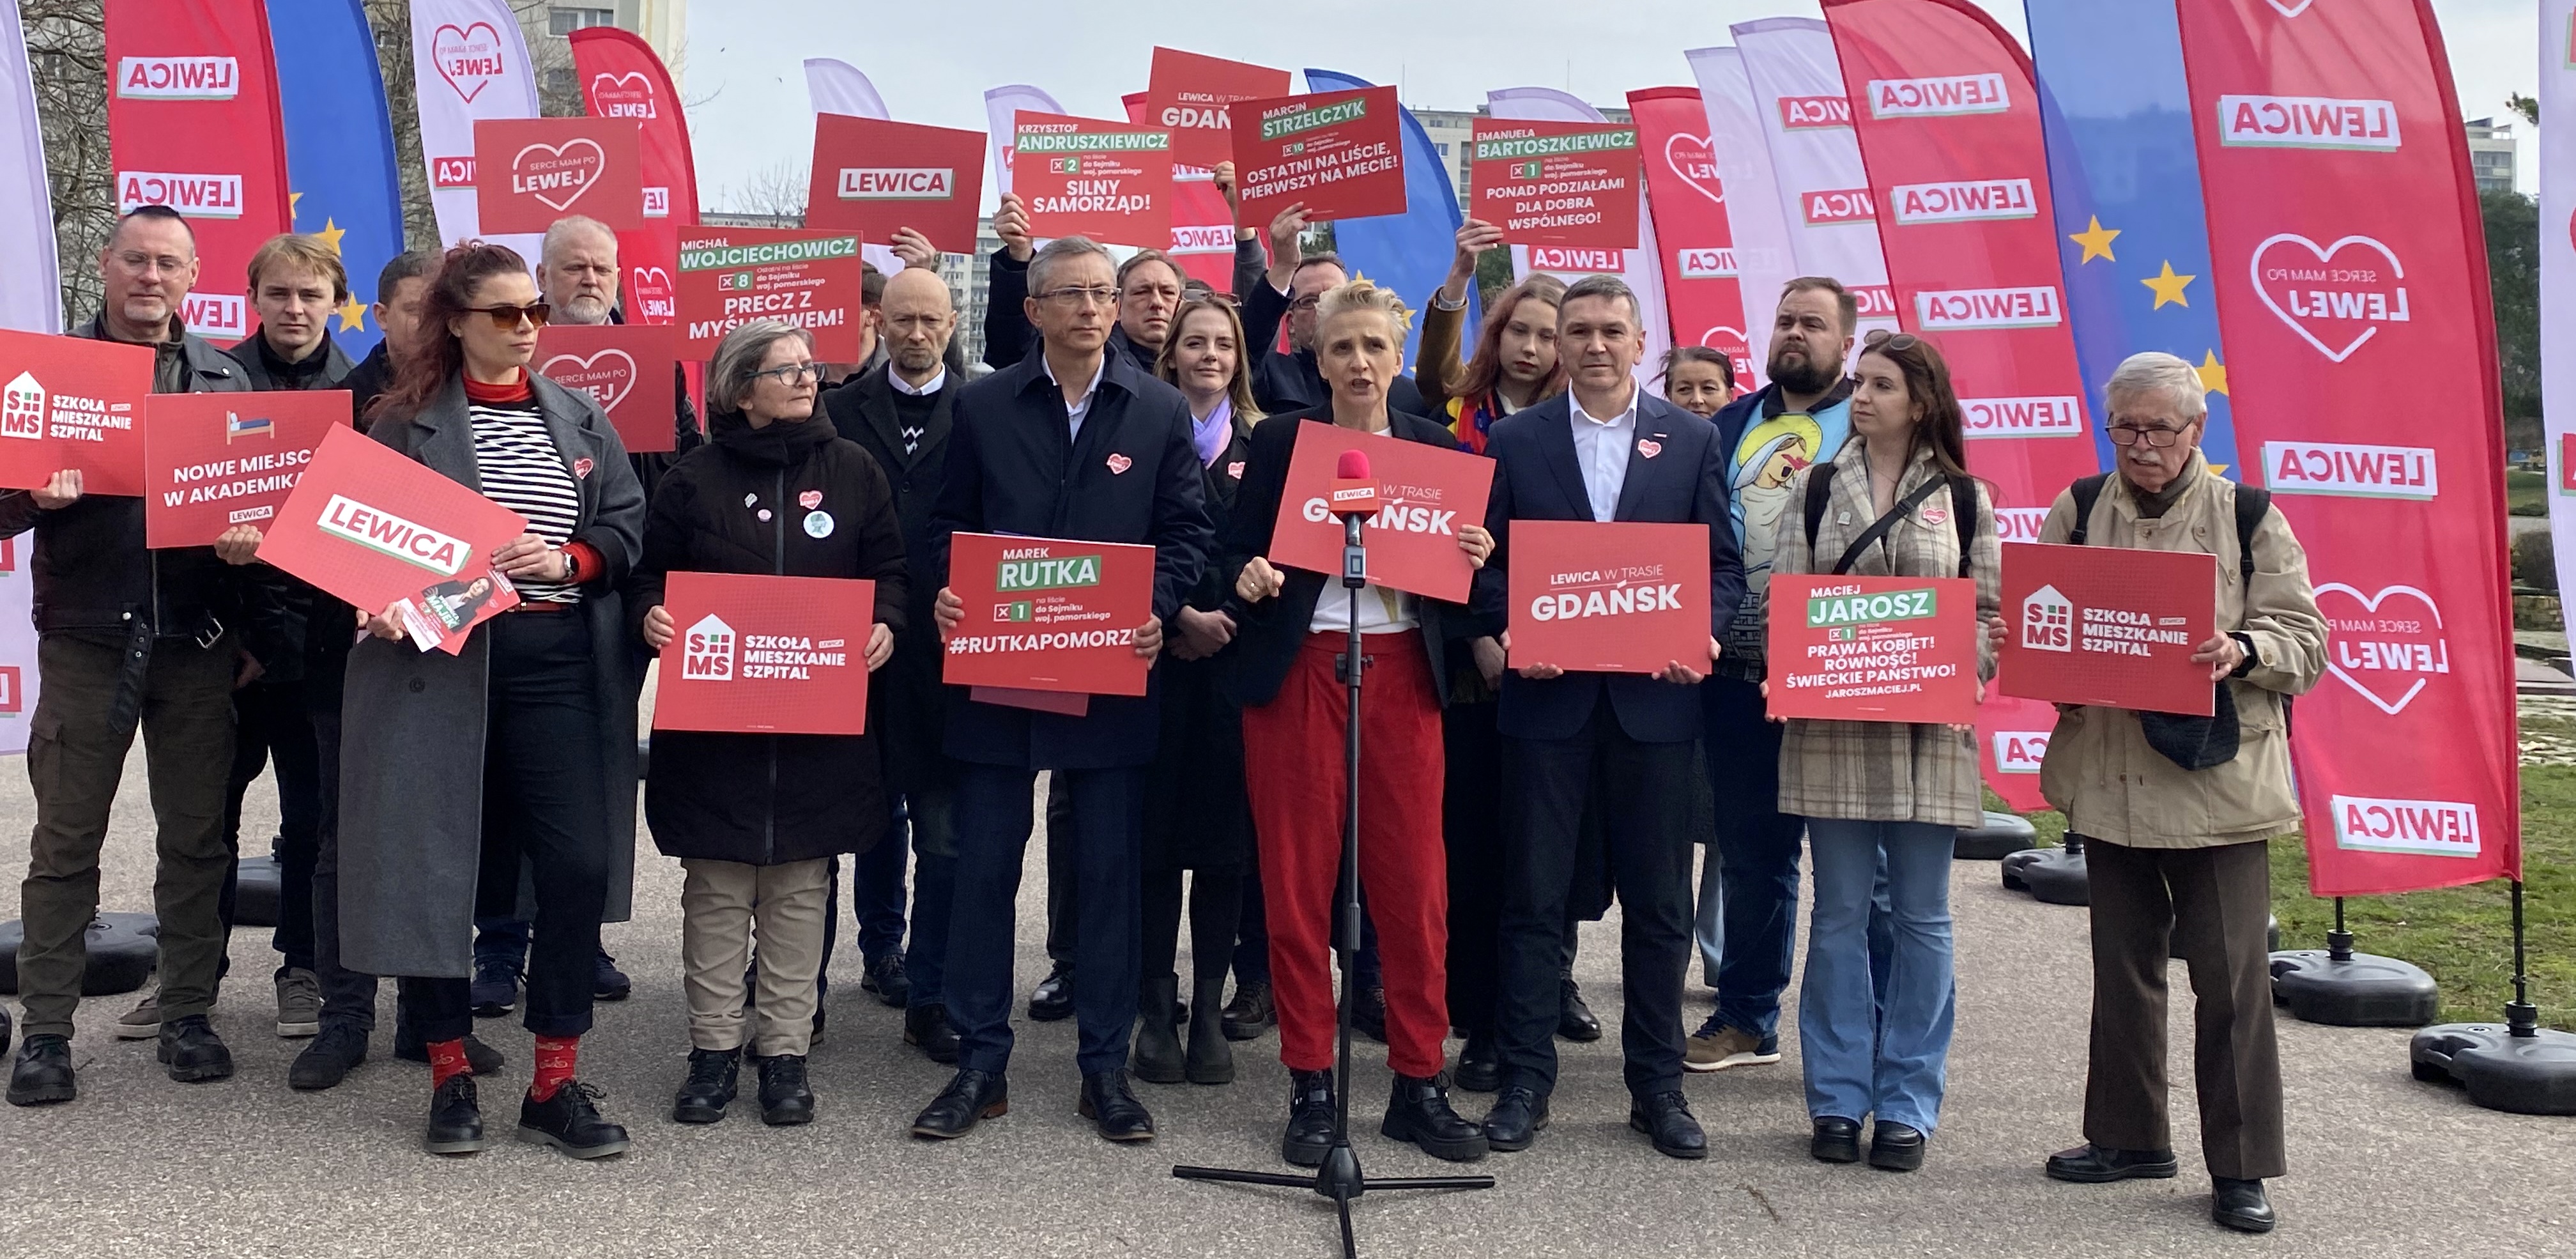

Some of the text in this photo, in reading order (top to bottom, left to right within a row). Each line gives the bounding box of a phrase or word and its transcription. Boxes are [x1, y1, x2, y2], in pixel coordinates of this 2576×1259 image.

[1178, 92, 1213, 102] LEWICA
[1216, 95, 1225, 103] W
[1162, 105, 1231, 130] GDAŃ
[1262, 102, 1307, 120] MARCIN
[1263, 100, 1365, 137] STRZELCZYK
[1018, 124, 1078, 134] KRZYSZTOF
[1476, 128, 1535, 141] EMANUELA
[1018, 134, 1168, 150] ANDRUSZKIEWICZ
[1293, 143, 1303, 153] 10
[1478, 132, 1634, 158] BARTOSZKIEWICZ
[530, 156, 596, 171] SERCE MAM PO
[1068, 160, 1077, 171] 2
[1247, 158, 1312, 183] OSTATNI
[1316, 153, 1338, 169] NA
[1341, 142, 1391, 164] LIŚCIE,
[1530, 164, 1535, 176] 1
[512, 169, 585, 194] LEWEJ
[846, 173, 945, 192] LEWICA
[1242, 155, 1398, 201] PIERWSZY NA MECIE!
[1066, 180, 1121, 196] SILNY
[1487, 178, 1625, 199] PONAD PODZIAŁAMI
[1033, 194, 1151, 215] SAMORZĄD!
[1516, 197, 1595, 213] DLA DOBRA
[1508, 211, 1602, 230] WSPÓLNEGO!
[680, 238, 855, 268] WOJCIECHOWICZ
[681, 237, 729, 251] MICHAŁ
[739, 274, 748, 287] 8
[769, 272, 800, 281] Sejmiku
[774, 278, 825, 290] pomorskiego
[724, 291, 811, 314] PRECZ Z
[555, 369, 627, 384] SERCE MAM PO
[52, 395, 105, 413] SZKOŁA
[51, 410, 132, 430] MIESZKANIE
[50, 424, 104, 442] SZPITAL
[174, 449, 311, 483] NOWE MIEJSC
[164, 472, 304, 507] W AKADEMIK
[1336, 489, 1373, 500] LEWICA
[1383, 484, 1443, 500] W TRASIE
[232, 507, 271, 521] LEWICA
[1303, 497, 1457, 536] GŃSK
[328, 502, 454, 568] LEWICA
[1003, 548, 1049, 560] MAREK
[1001, 559, 1097, 588] RUTKA
[1550, 564, 1664, 585] LEWICA W TRASIE
[1531, 580, 1682, 622] GDAŃSK
[1811, 585, 1861, 599] MACIEJ
[427, 595, 460, 629] MAJEK
[1017, 605, 1023, 619] 1
[1048, 603, 1083, 614] Sejmiku
[1811, 592, 1929, 624] JAROSZ
[2083, 608, 2151, 626] SZKOŁA
[1035, 611, 1111, 624] woj. pomorskiego
[949, 628, 1138, 654] #RUTKAPOMORZ
[1846, 629, 1851, 639] 1
[2082, 622, 2189, 645] MIESZKANIE
[746, 635, 811, 651] SZKOŁA
[1807, 636, 1935, 658] PRAWA KOBIET!
[2082, 638, 2151, 657] SZPITAL
[744, 650, 846, 667] MIESZKANIE
[1825, 651, 1917, 671] RÓWNOŚĆ!
[742, 665, 810, 680] SZPITAL
[1786, 663, 1956, 689] ŚWIECKIE PAŃSTWO!
[1825, 683, 1922, 699] JAROSZMACIEJ.PL
